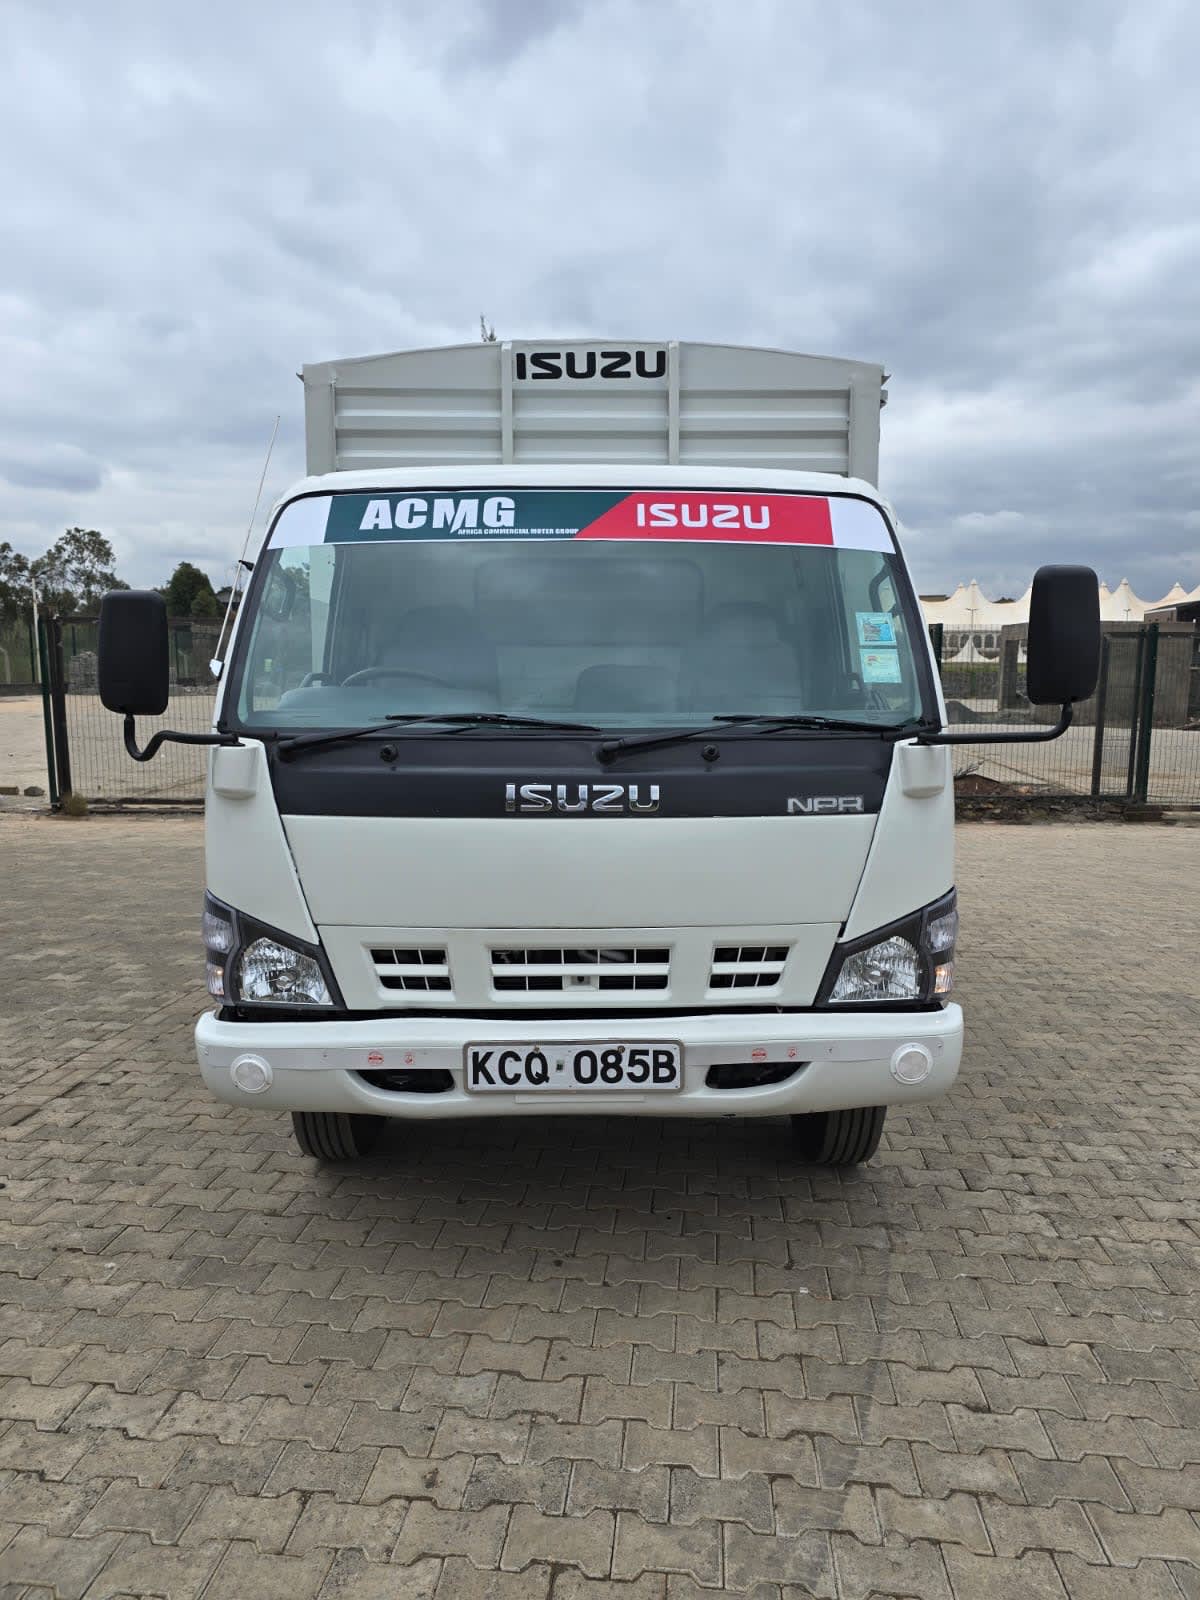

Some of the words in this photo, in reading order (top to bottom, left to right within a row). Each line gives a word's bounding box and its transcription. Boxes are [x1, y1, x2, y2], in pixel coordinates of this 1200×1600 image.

[516, 351, 666, 379] ISUZU
[359, 496, 515, 533] ACMG
[636, 503, 770, 529] ISUZU
[505, 784, 660, 813] ISUZU
[787, 796, 865, 813] NPR
[472, 1050, 550, 1085] KCQ
[573, 1049, 677, 1084] 085B
